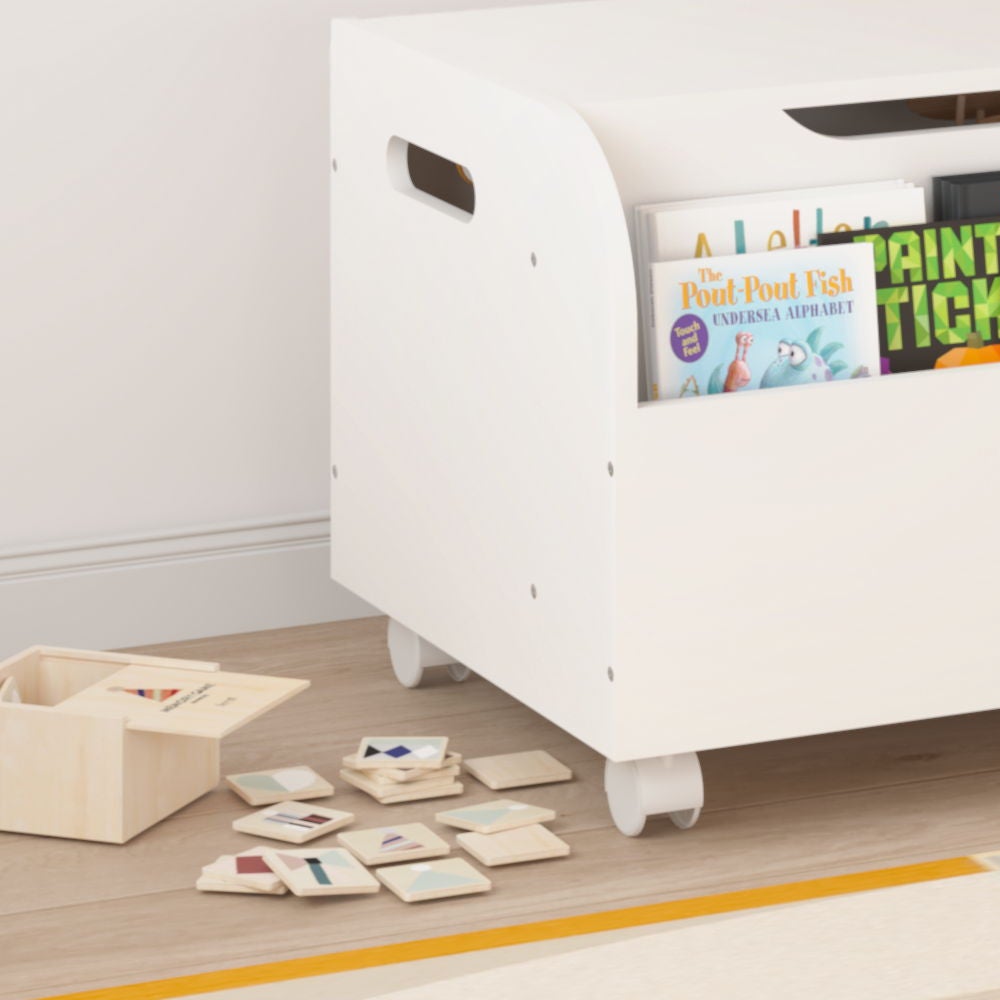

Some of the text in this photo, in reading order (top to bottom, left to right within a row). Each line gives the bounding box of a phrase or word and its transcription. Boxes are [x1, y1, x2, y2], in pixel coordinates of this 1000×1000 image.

[698, 268, 722, 283] The
[679, 272, 801, 310] Pout-Pout
[804, 268, 854, 298] Fish
[713, 300, 854, 327] UNDERSEA ALPHABET
[674, 320, 701, 338] Touch
[682, 331, 698, 347] and
[682, 342, 701, 358] Feel
